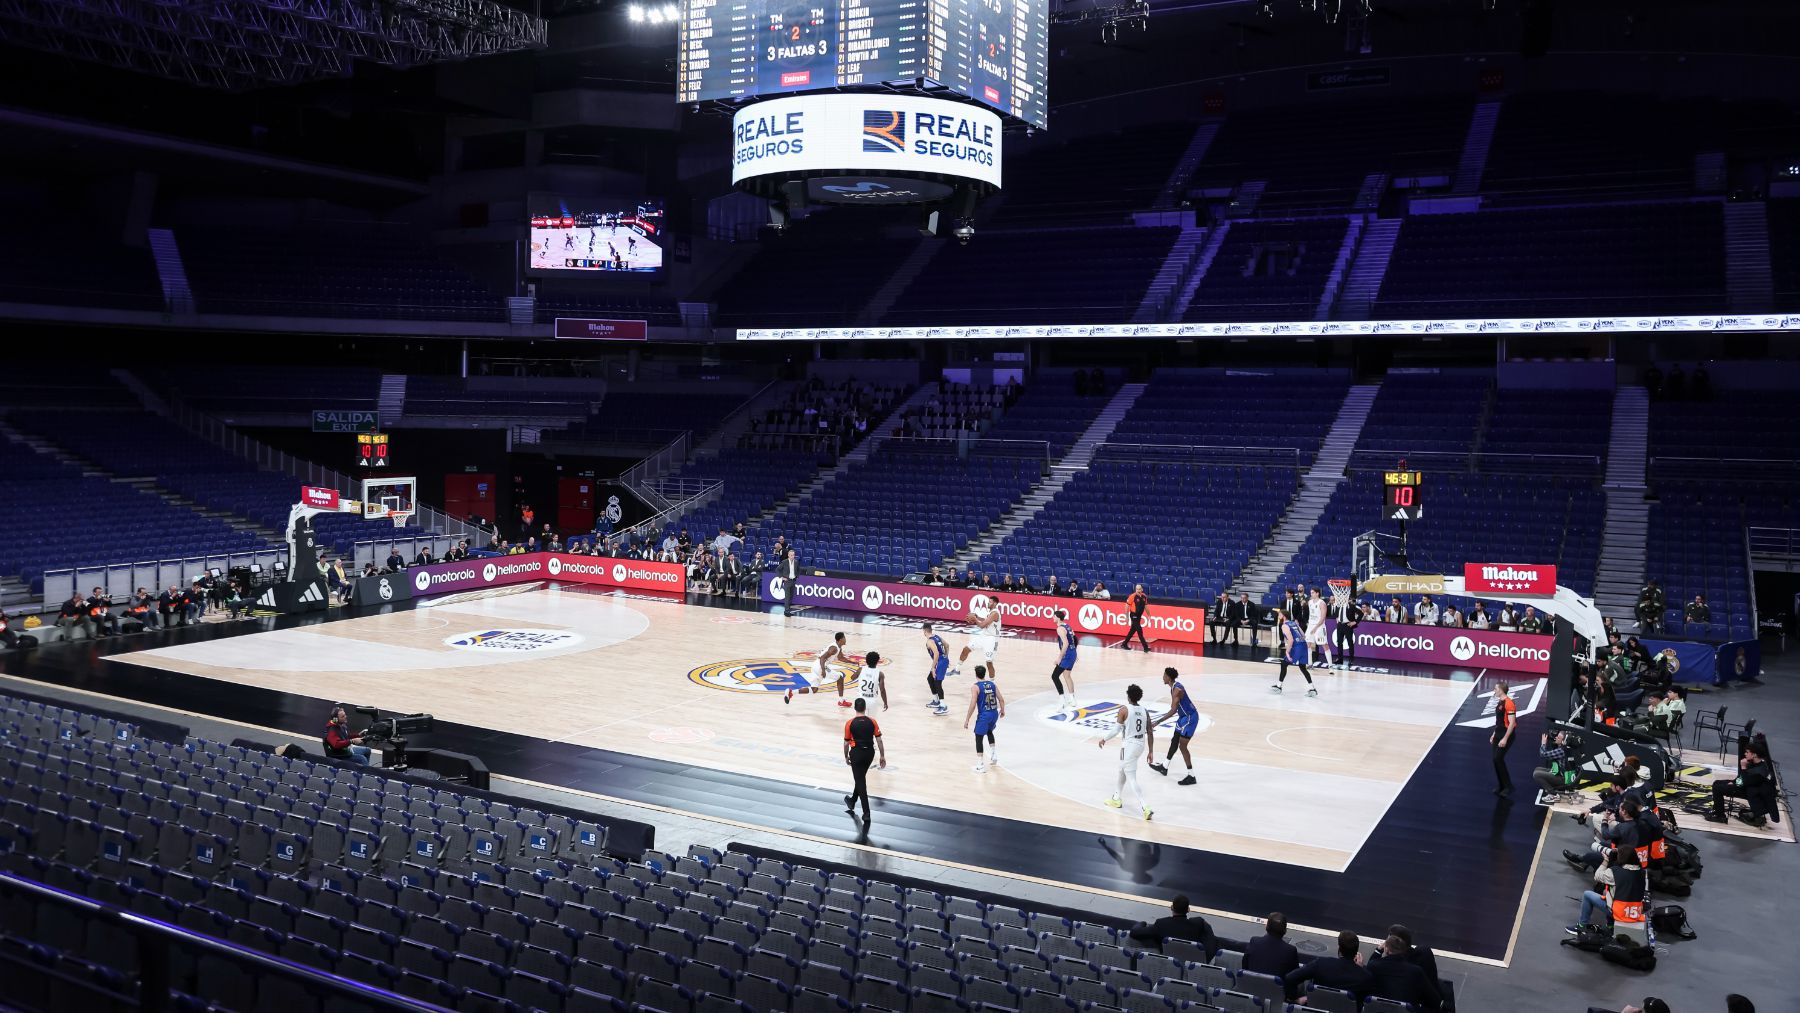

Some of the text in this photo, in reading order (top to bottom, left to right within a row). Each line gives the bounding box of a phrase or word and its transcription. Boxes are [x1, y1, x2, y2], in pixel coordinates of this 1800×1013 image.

[770, 14, 783, 23] TM
[811, 8, 824, 18] TM
[791, 26, 800, 40] 2
[767, 40, 827, 60] 3 FALTAS 3
[990, 43, 996, 57] 2
[848, 63, 860, 73] LEAF
[978, 54, 1008, 81] 3 FALTAS 3
[688, 80, 701, 91] FELIZ
[847, 74, 863, 84] BLATT
[737, 112, 804, 144] REALE
[915, 113, 993, 148] REALE
[737, 139, 804, 165] SEGUROS
[915, 140, 993, 166] SEGUROS
[316, 412, 374, 424] SALIDA
[333, 423, 358, 431] EXIT
[362, 445, 371, 457] 10
[377, 444, 387, 457] 10
[308, 489, 332, 500] Mahou
[1394, 487, 1413, 506] 10
[497, 562, 541, 575] hellomoto
[562, 563, 604, 575] motorola
[1482, 566, 1538, 581] Mahou
[431, 569, 475, 584] motorola
[628, 568, 679, 583] hellomoto
[795, 583, 855, 600] motorola
[1385, 582, 1443, 592] ETIHAD
[885, 590, 962, 611] hellomoto
[1106, 610, 1195, 632] helomoto
[1357, 633, 1434, 651] motorola
[1478, 642, 1550, 661] hellomo
[861, 679, 874, 693] 24
[985, 693, 996, 707] 45
[1136, 718, 1142, 732] 8
[539, 837, 546, 846] C
[589, 833, 596, 842] B
[205, 847, 213, 858] H
[286, 845, 294, 856] G
[360, 843, 367, 853] F
[426, 843, 433, 853] E
[485, 842, 492, 851] D
[323, 878, 329, 889] H
[401, 876, 408, 886] G
